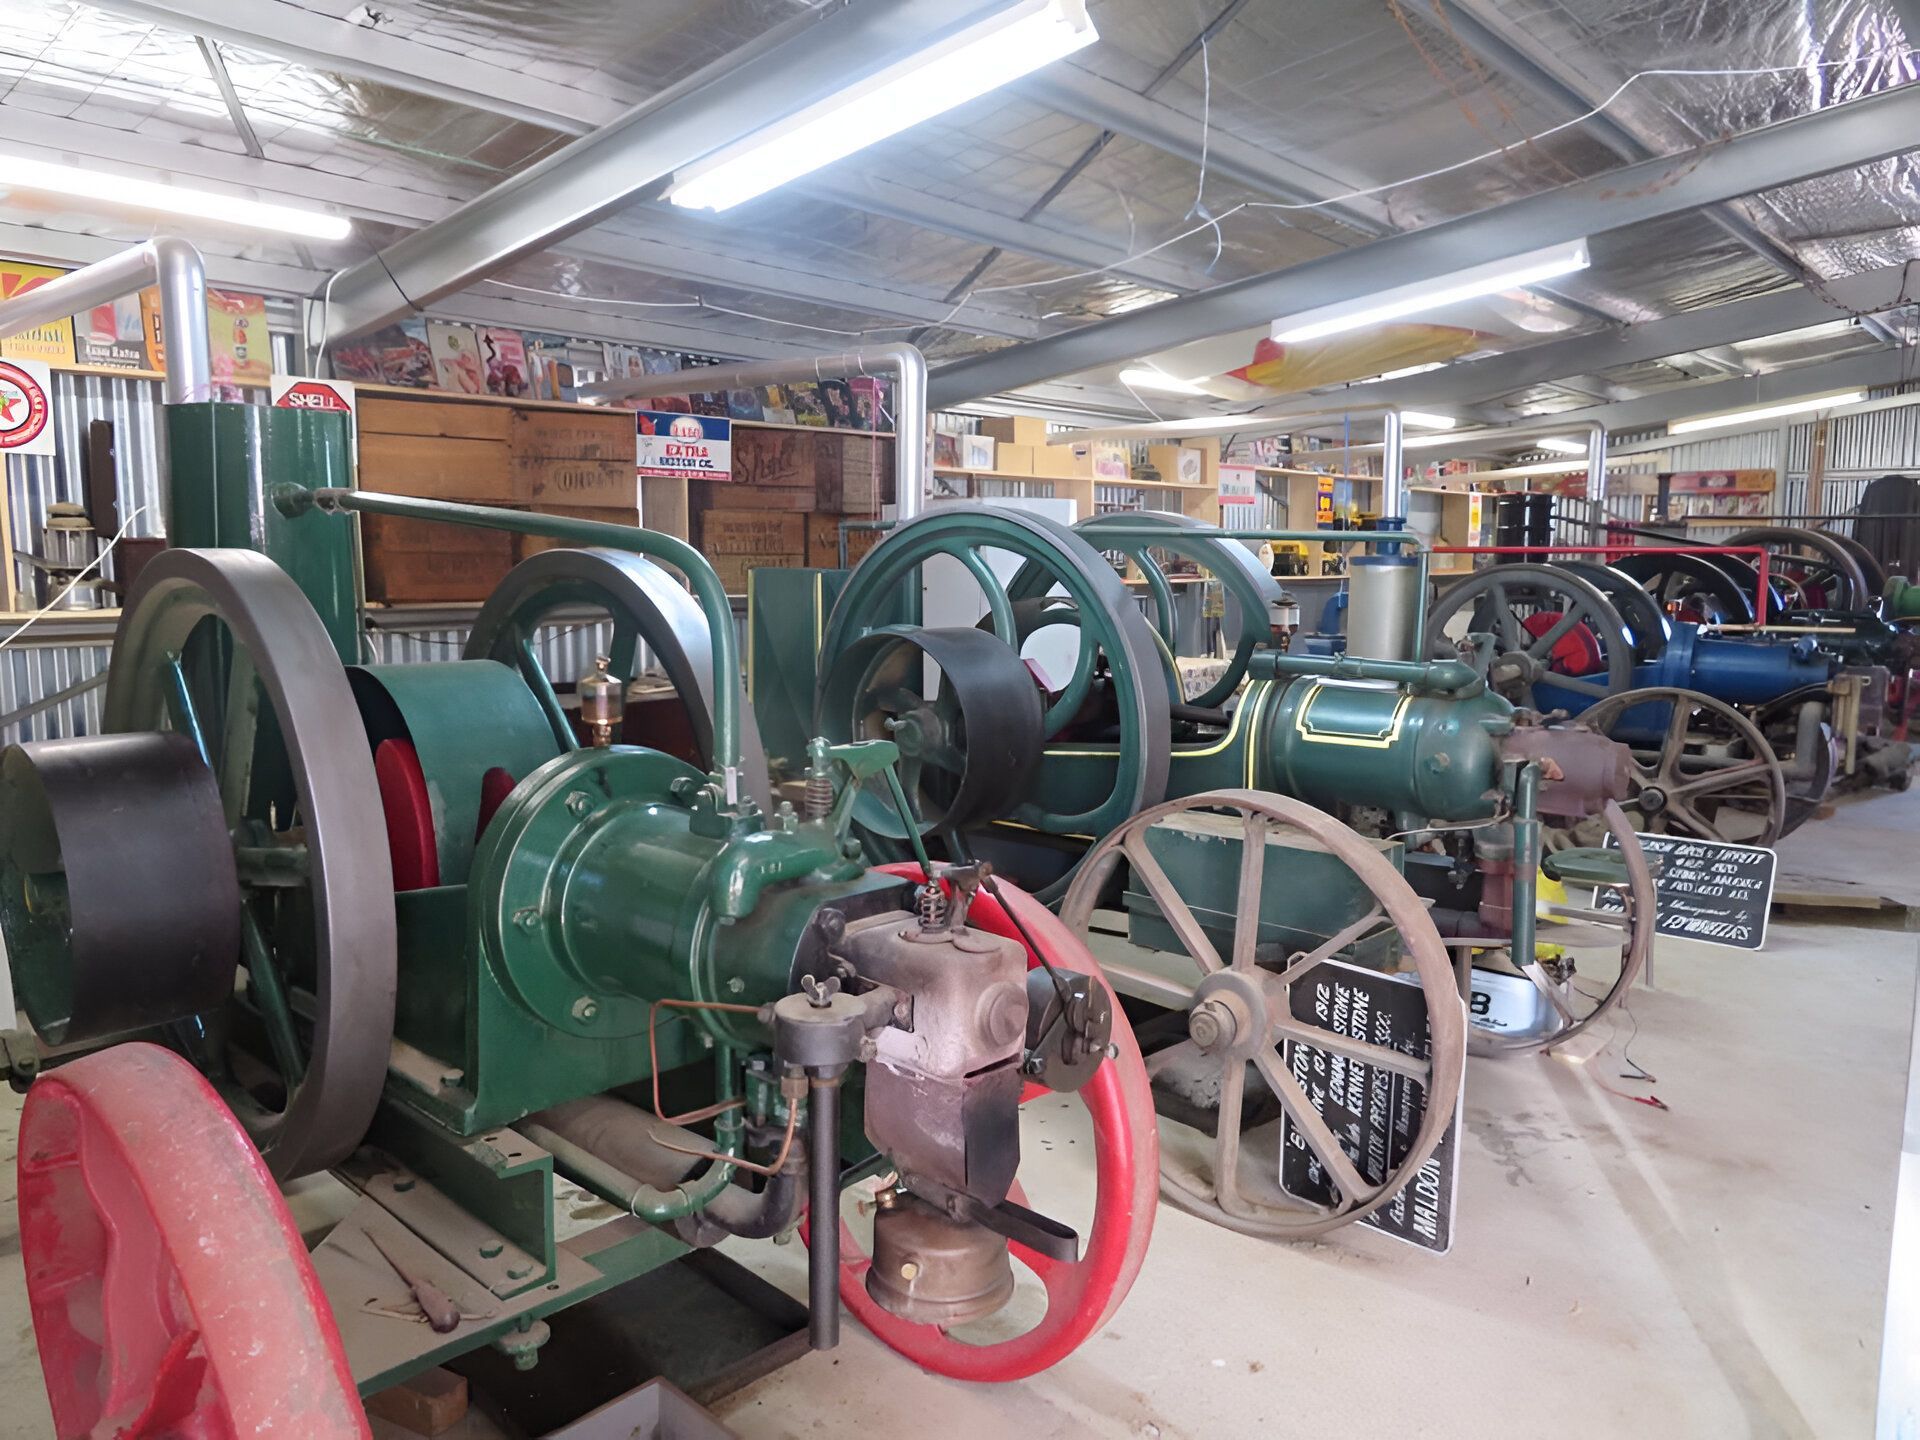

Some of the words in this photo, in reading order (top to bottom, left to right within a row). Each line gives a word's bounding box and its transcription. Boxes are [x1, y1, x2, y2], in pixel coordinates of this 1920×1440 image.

[288, 392, 340, 409] SHELL
[1333, 983, 1351, 1036] STONE
[1351, 987, 1370, 1042] STONE
[1346, 1060, 1366, 1118] KENNET
[1413, 1157, 1441, 1240] MALDON
